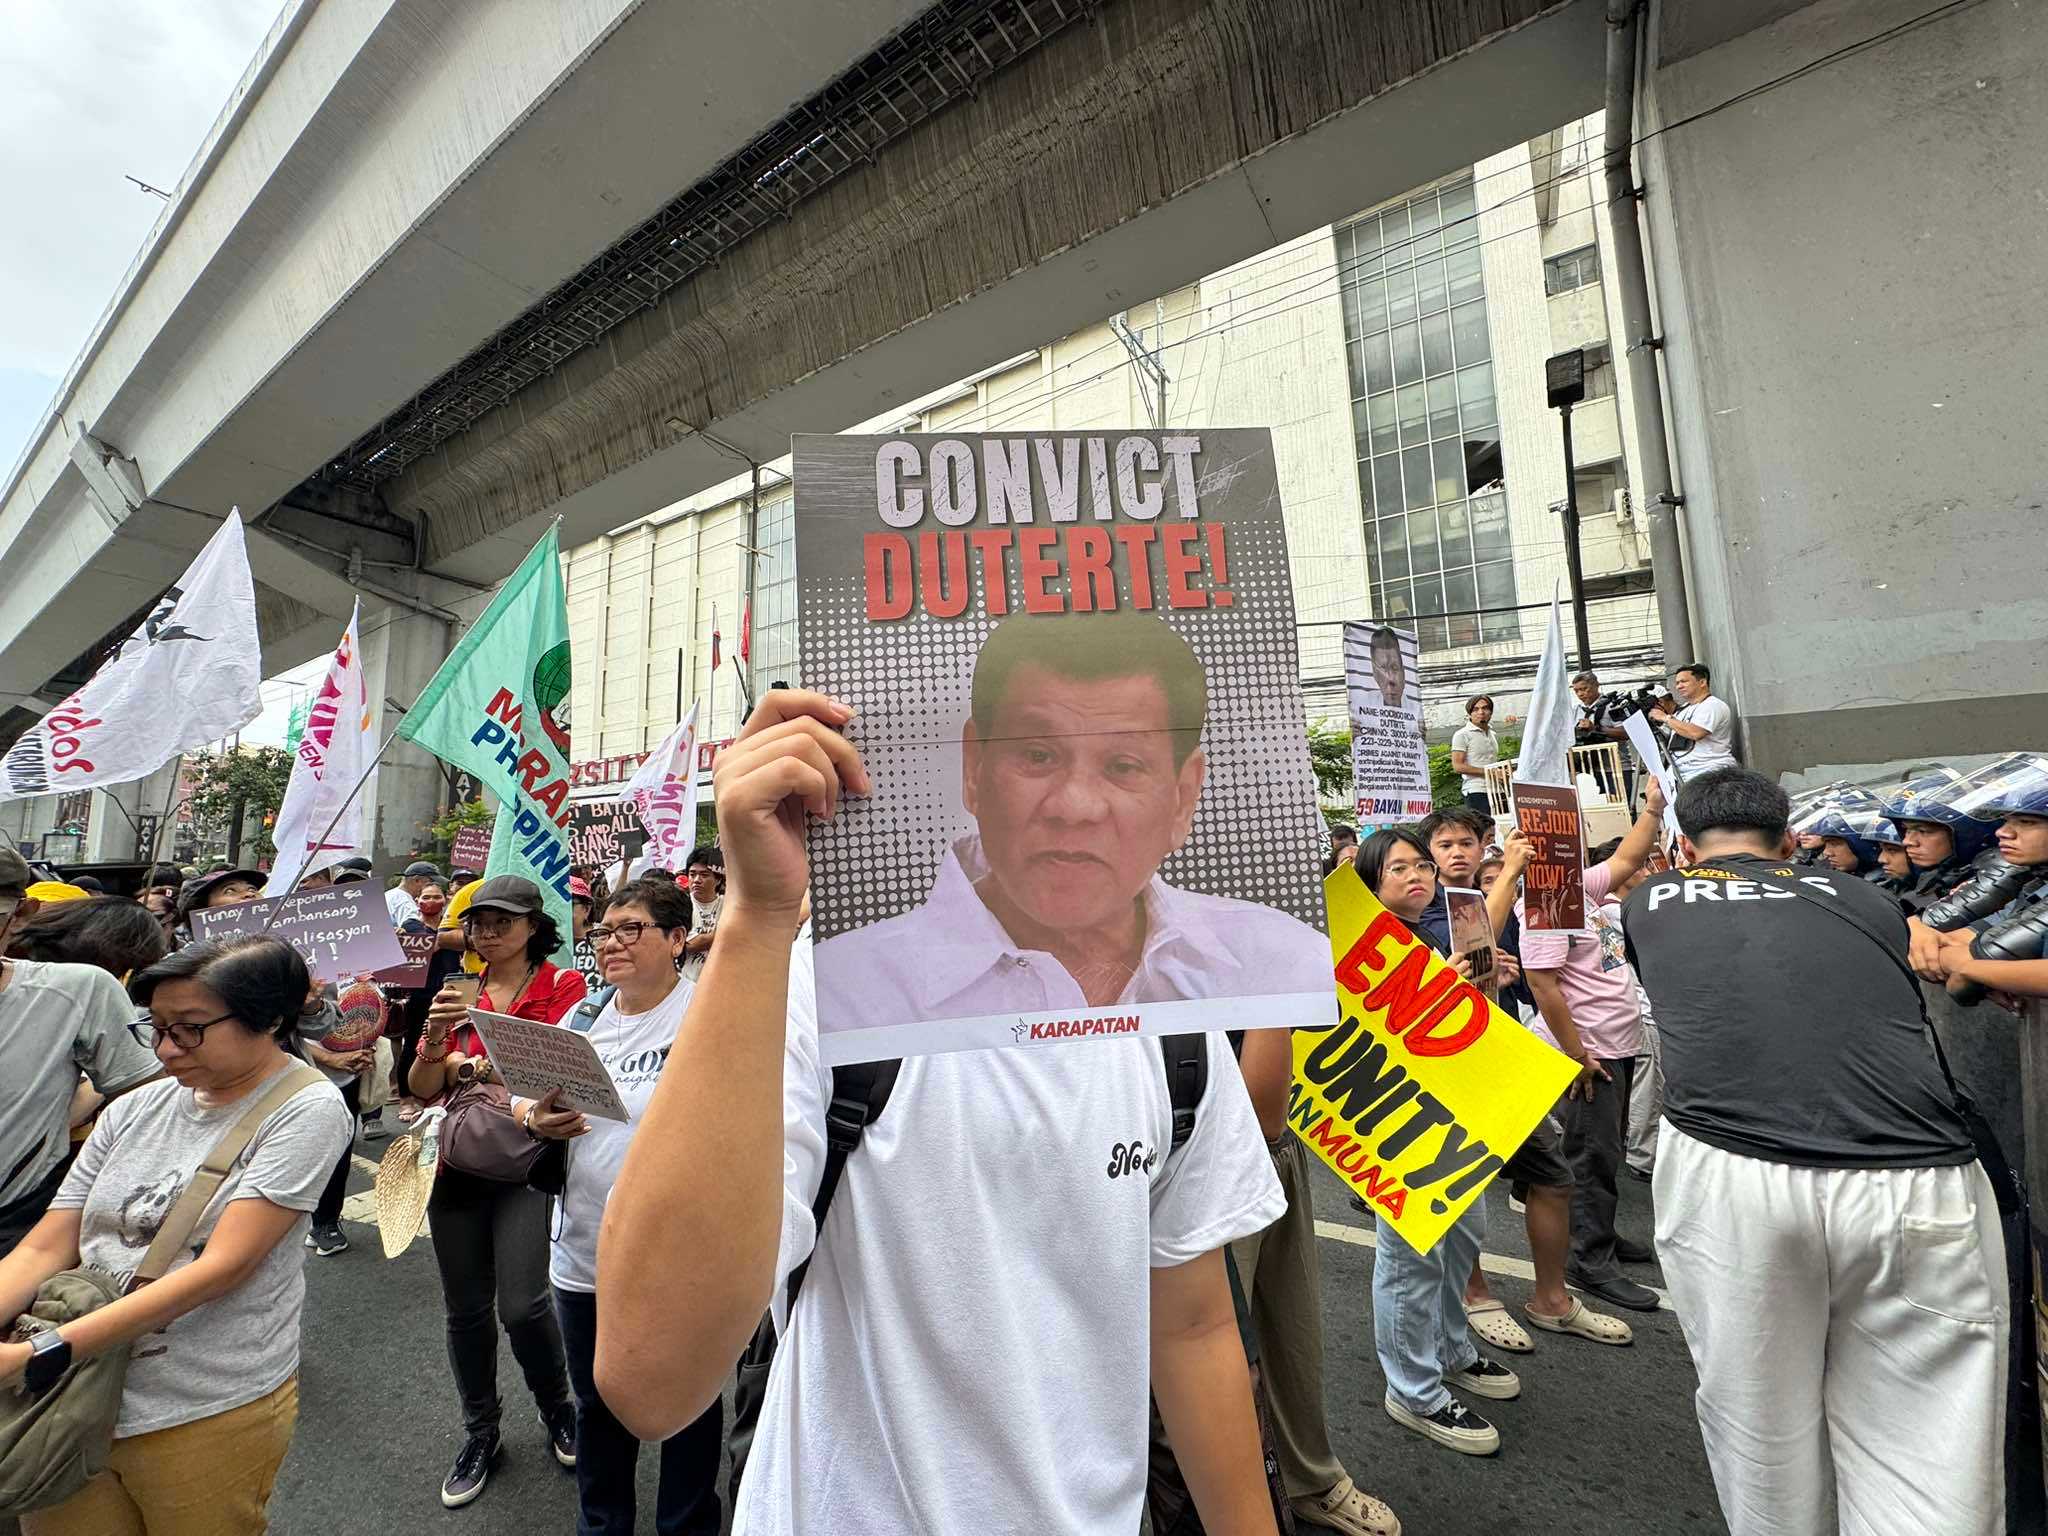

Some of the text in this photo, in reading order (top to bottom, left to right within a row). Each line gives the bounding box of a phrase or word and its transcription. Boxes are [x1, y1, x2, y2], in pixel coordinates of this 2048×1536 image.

[875, 436, 1201, 528] CONVICT
[863, 522, 1233, 621] DUTERTE!
[1356, 798, 1374, 816] 59
[1373, 799, 1403, 815] BAYAN
[1518, 807, 1578, 836] REJOIN
[584, 823, 611, 836] AND
[611, 814, 640, 833] ALL
[1526, 863, 1566, 889] NOW!
[196, 908, 245, 925] Tunay
[251, 903, 270, 915] na
[343, 889, 363, 900] sa
[1335, 910, 1490, 1057] END
[1030, 1015, 1140, 1039] KARAPATAN
[1300, 1011, 1505, 1215] UNITY!
